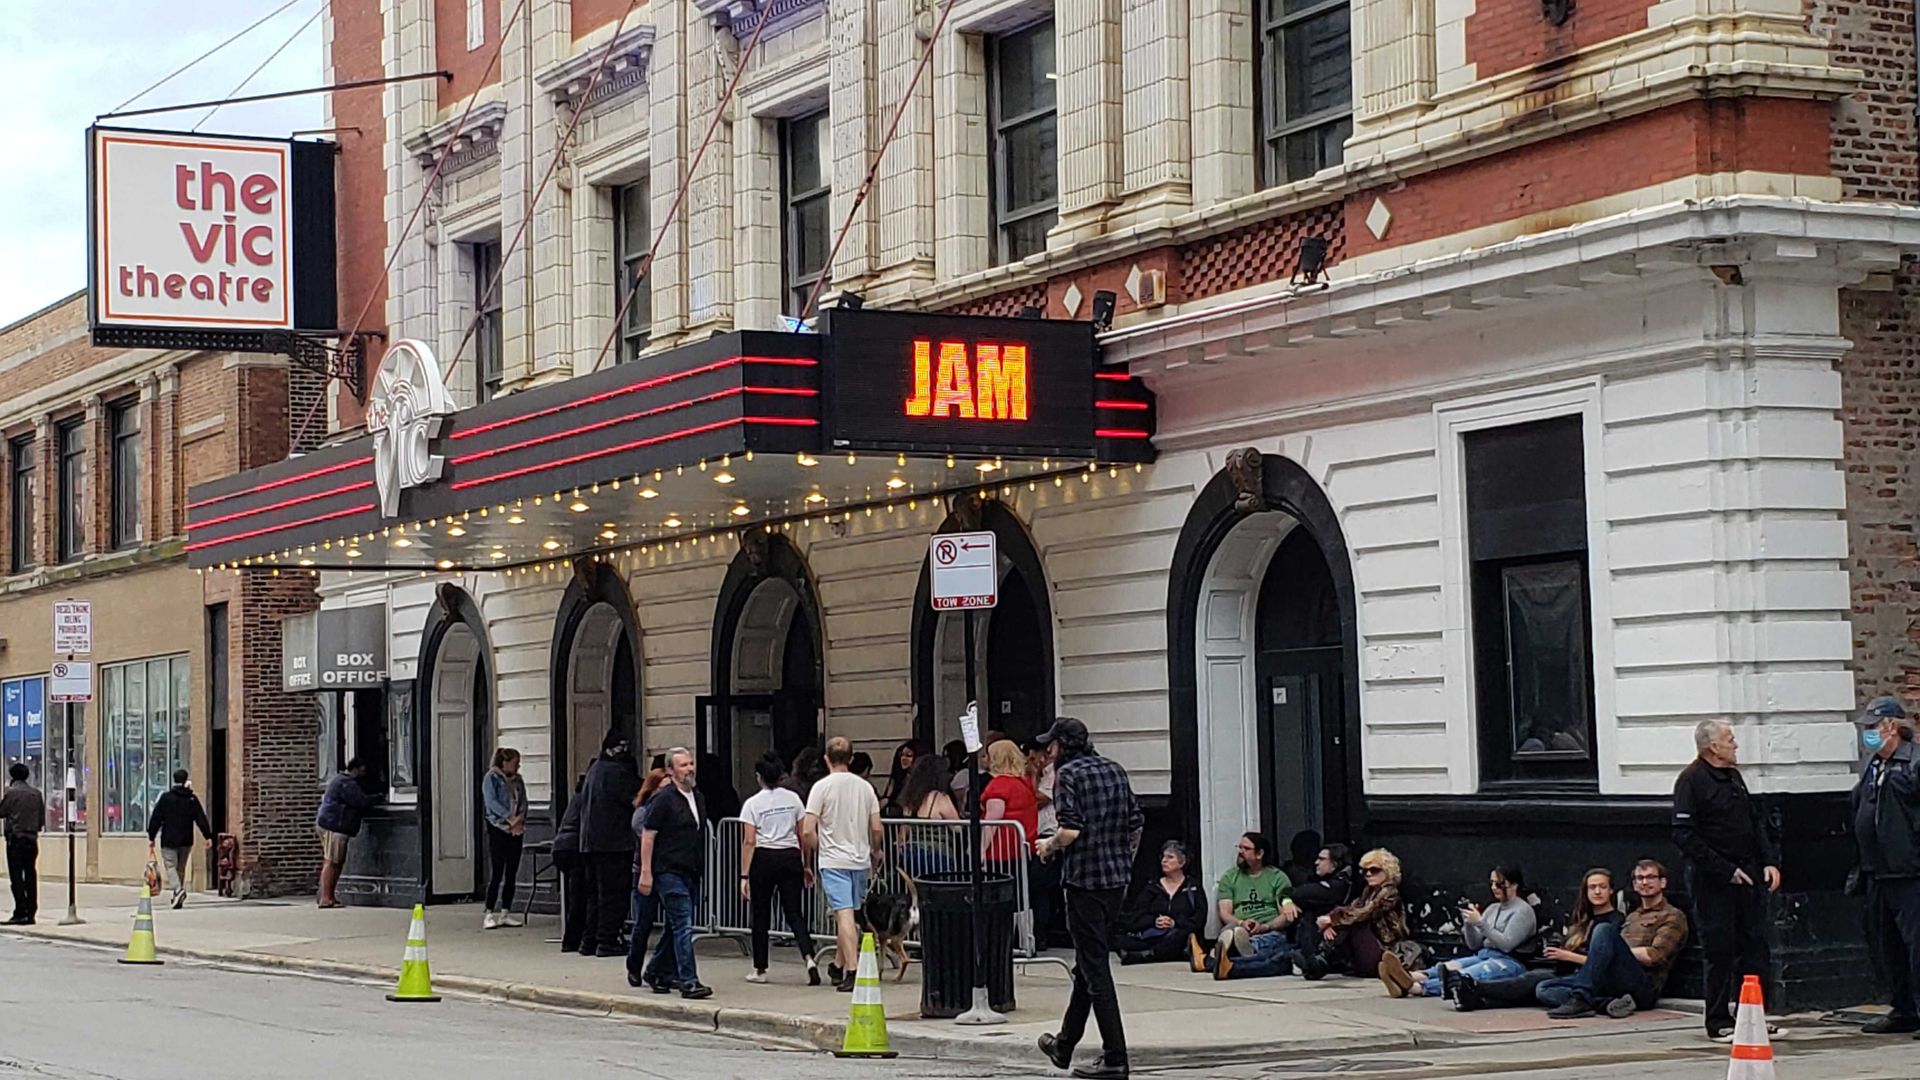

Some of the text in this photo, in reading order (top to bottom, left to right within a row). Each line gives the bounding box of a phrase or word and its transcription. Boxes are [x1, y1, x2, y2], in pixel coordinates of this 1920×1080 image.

[176, 162, 278, 214] the
[179, 215, 273, 266] vic
[119, 265, 274, 307] theatre
[905, 340, 1028, 420] JAM
[367, 402, 389, 431] the
[937, 596, 990, 607] TOW ZONE
[293, 656, 307, 669] BOX
[336, 653, 374, 667] BOX
[289, 673, 312, 687] OFFICE
[322, 670, 387, 684] OFFICE
